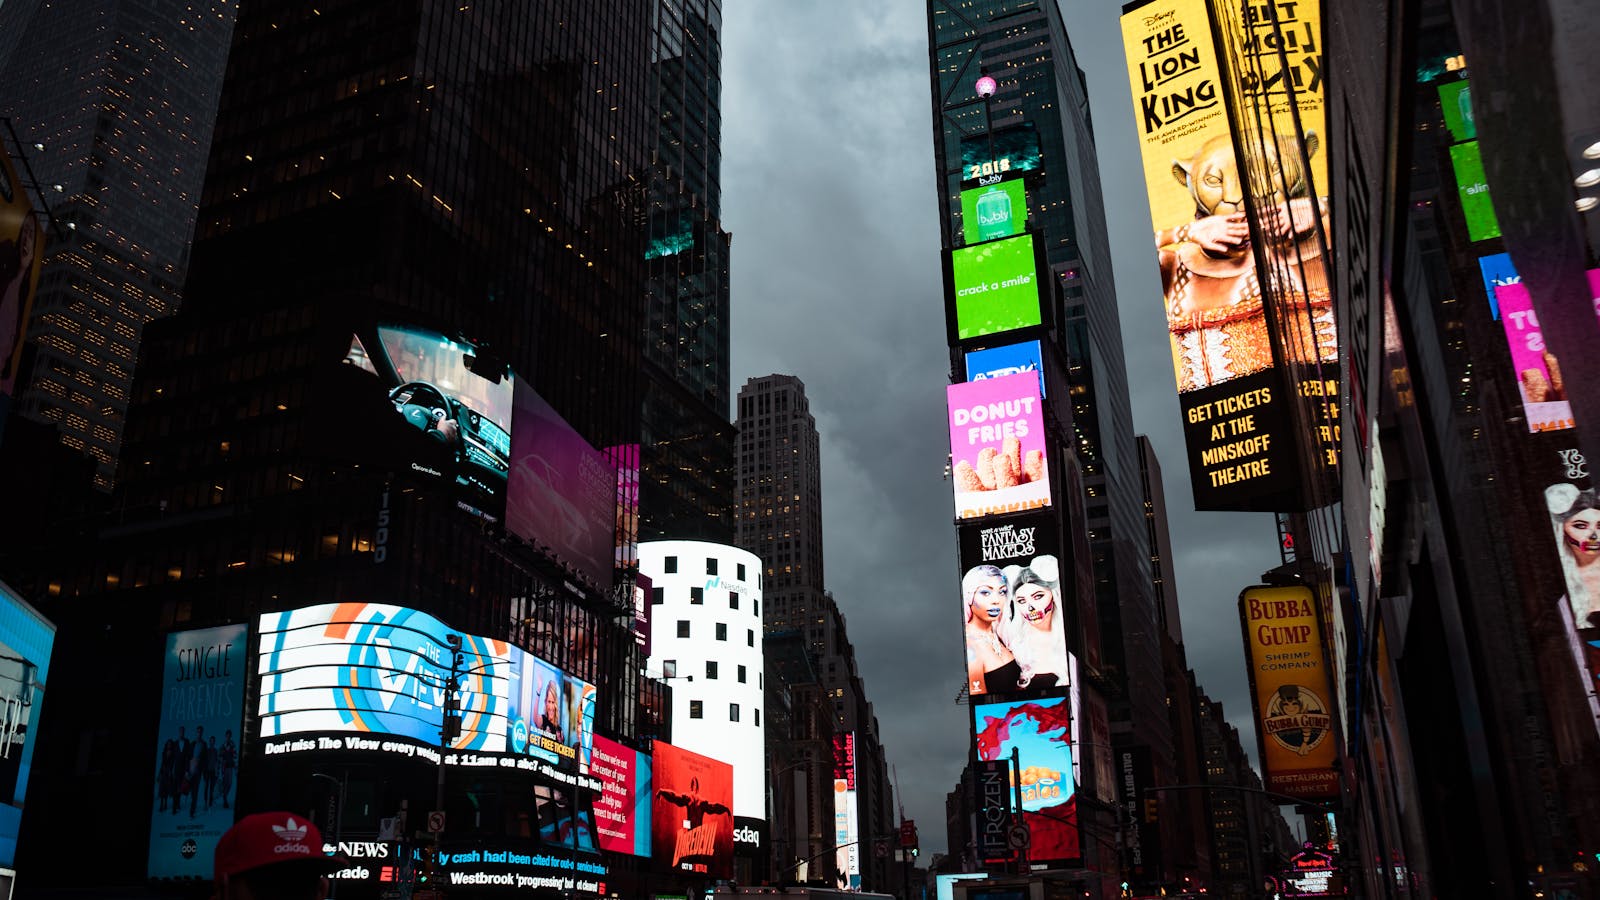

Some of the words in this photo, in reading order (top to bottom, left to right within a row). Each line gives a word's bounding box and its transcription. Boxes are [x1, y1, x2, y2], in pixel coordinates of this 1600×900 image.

[1142, 10, 1175, 26] Disney
[1143, 23, 1185, 53] THE
[1139, 47, 1200, 93] LION
[1141, 80, 1216, 134] KING
[1147, 134, 1160, 143] THE
[1161, 110, 1222, 138] AWARD-WINNING
[1161, 134, 1176, 144] BEST
[1178, 124, 1208, 138] MUSICAL
[970, 158, 1010, 179] 2018
[958, 282, 988, 297] crack
[991, 281, 999, 290] a
[954, 396, 1035, 426] DONUT
[1188, 403, 1213, 424] GET
[1214, 387, 1272, 416] TICKETS
[968, 419, 1029, 445] FRIES
[1210, 422, 1226, 441] AT
[1228, 414, 1256, 436] THE
[1202, 433, 1271, 467] MINSKOFF
[1209, 458, 1271, 488] THEATRE
[373, 491, 391, 564] 1500
[980, 527, 1035, 548] FANTASY
[982, 540, 1036, 562] MAKERS
[721, 581, 748, 596] Nasdaq
[1248, 598, 1313, 620] BUBBA
[1257, 624, 1311, 646] GUMP
[176, 643, 232, 682] SINGLE
[425, 641, 440, 665] THE
[1266, 651, 1311, 662] SHRIMP
[1260, 660, 1318, 671] COMPANY
[169, 681, 234, 720] PARENTS
[1267, 716, 1298, 731] BUBBA
[265, 741, 291, 755] Don't
[291, 739, 316, 752] miss
[318, 737, 342, 750] The
[345, 736, 380, 750] View
[382, 741, 416, 757] every
[444, 753, 458, 765] at
[461, 754, 497, 766] 11am
[500, 758, 515, 767] on
[530, 733, 541, 746] GET
[541, 737, 554, 752] FREE
[844, 733, 854, 766] Locker
[1271, 772, 1339, 784] RESTAURANT
[1285, 784, 1329, 794] MARKET
[606, 794, 614, 809] help
[982, 771, 1007, 846] FROZEN
[672, 821, 718, 868] DAREDEVIL
[733, 826, 760, 847] sdaq
[181, 842, 197, 854] abc
[273, 842, 310, 855] adidas
[338, 842, 388, 858] NEWS
[452, 850, 480, 863] crash
[483, 850, 506, 863] had
[508, 851, 531, 865] been
[532, 854, 550, 866] cited
[551, 855, 559, 867] for
[560, 859, 574, 870] out-o
[450, 872, 514, 885] Westbrook
[516, 873, 564, 890] 'progressing'
[564, 877, 574, 889] but
